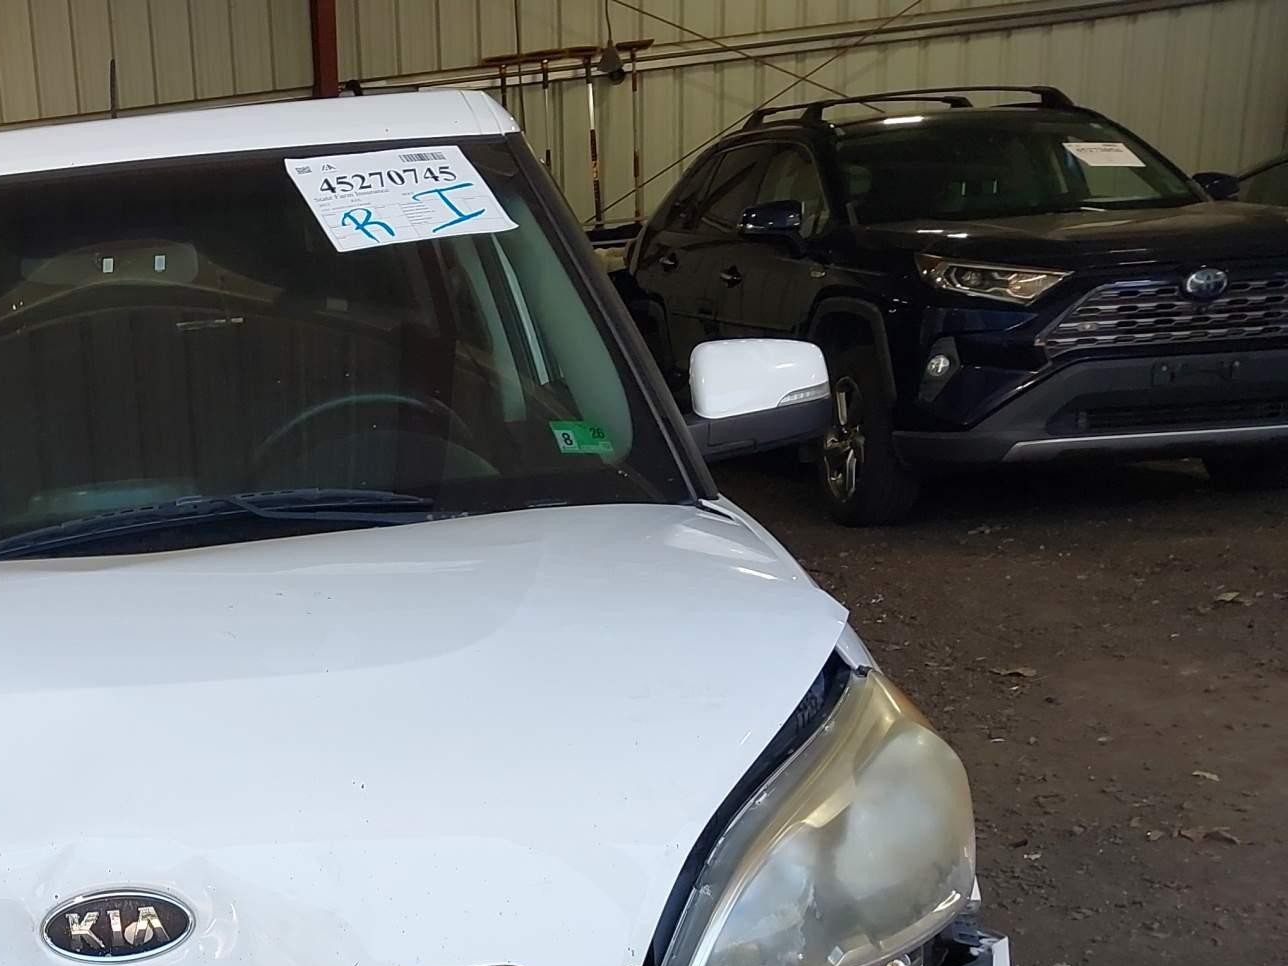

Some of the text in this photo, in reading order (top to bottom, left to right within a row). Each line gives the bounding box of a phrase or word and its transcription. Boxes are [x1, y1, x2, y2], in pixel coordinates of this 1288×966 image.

[319, 166, 457, 194] 45270745
[341, 207, 396, 243] R
[561, 432, 574, 446] 8
[65, 905, 171, 949] KIA
